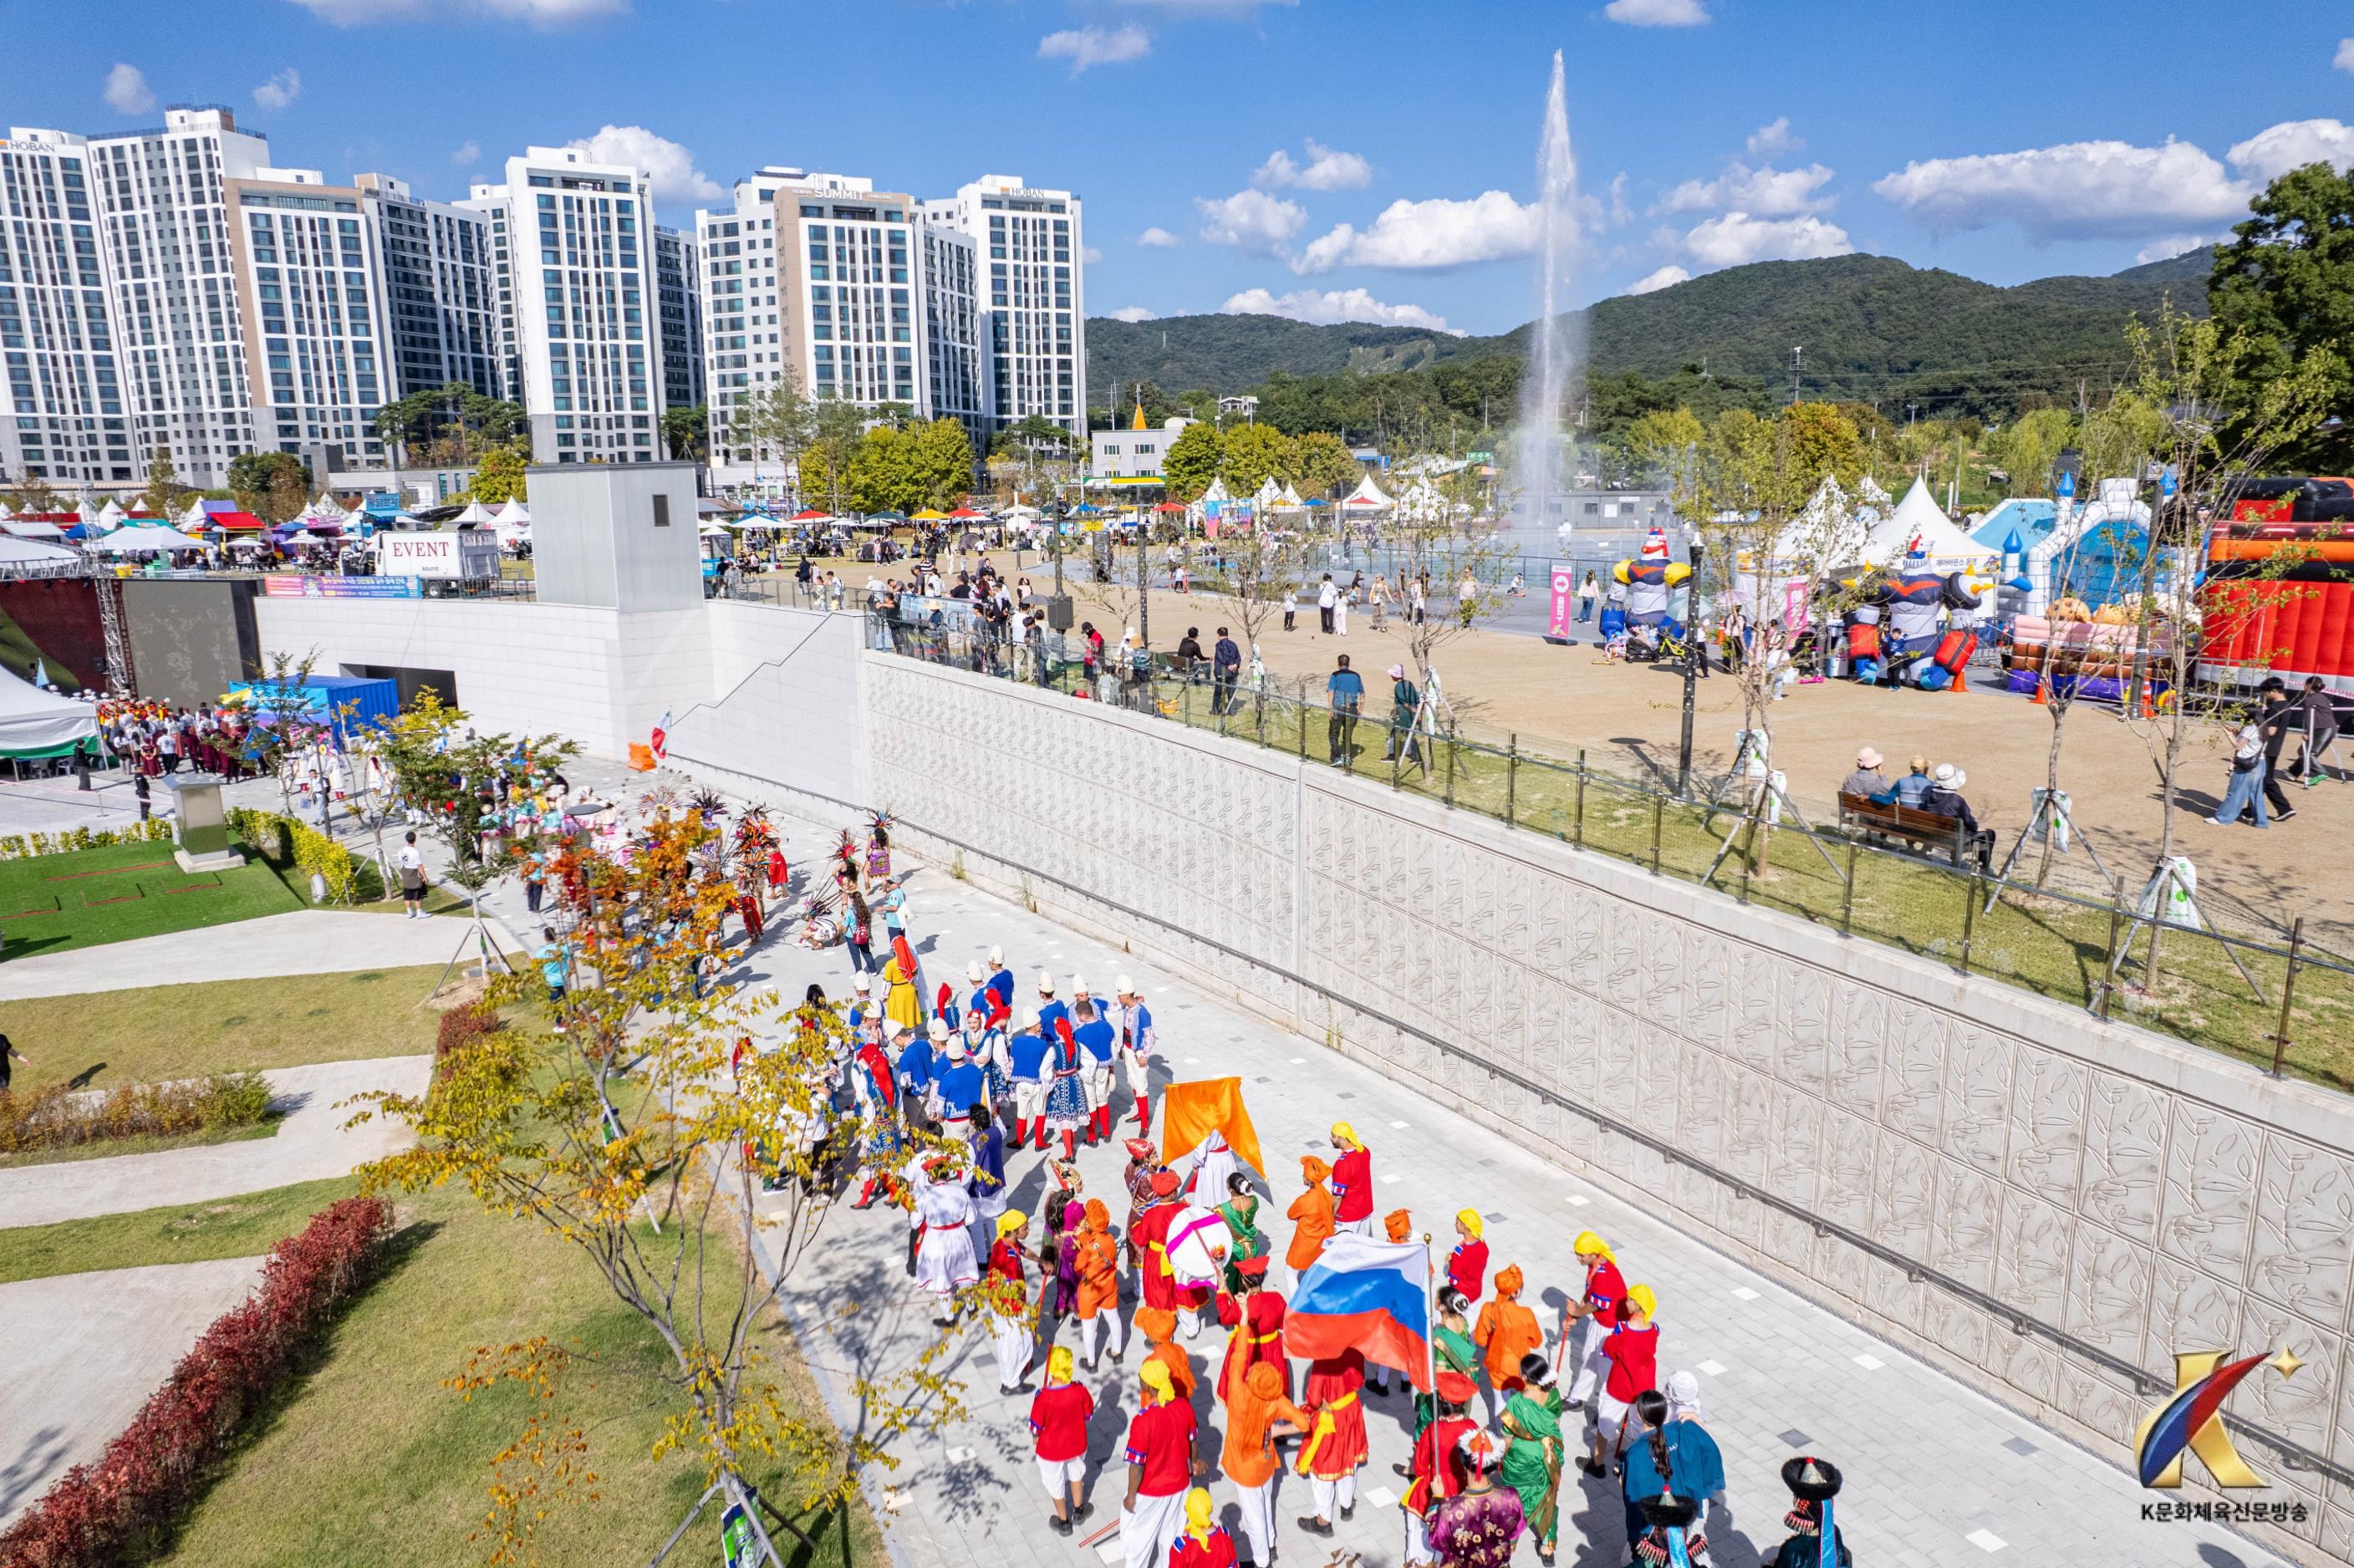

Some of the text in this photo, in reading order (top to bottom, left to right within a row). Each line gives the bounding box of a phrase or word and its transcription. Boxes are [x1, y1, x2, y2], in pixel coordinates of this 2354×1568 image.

[10, 140, 55, 152] HOBAN
[815, 188, 864, 201] SUMMIT
[1011, 187, 1044, 198] HOBAN
[465, 533, 490, 543] EVENT
[393, 542, 449, 557] EVENT
